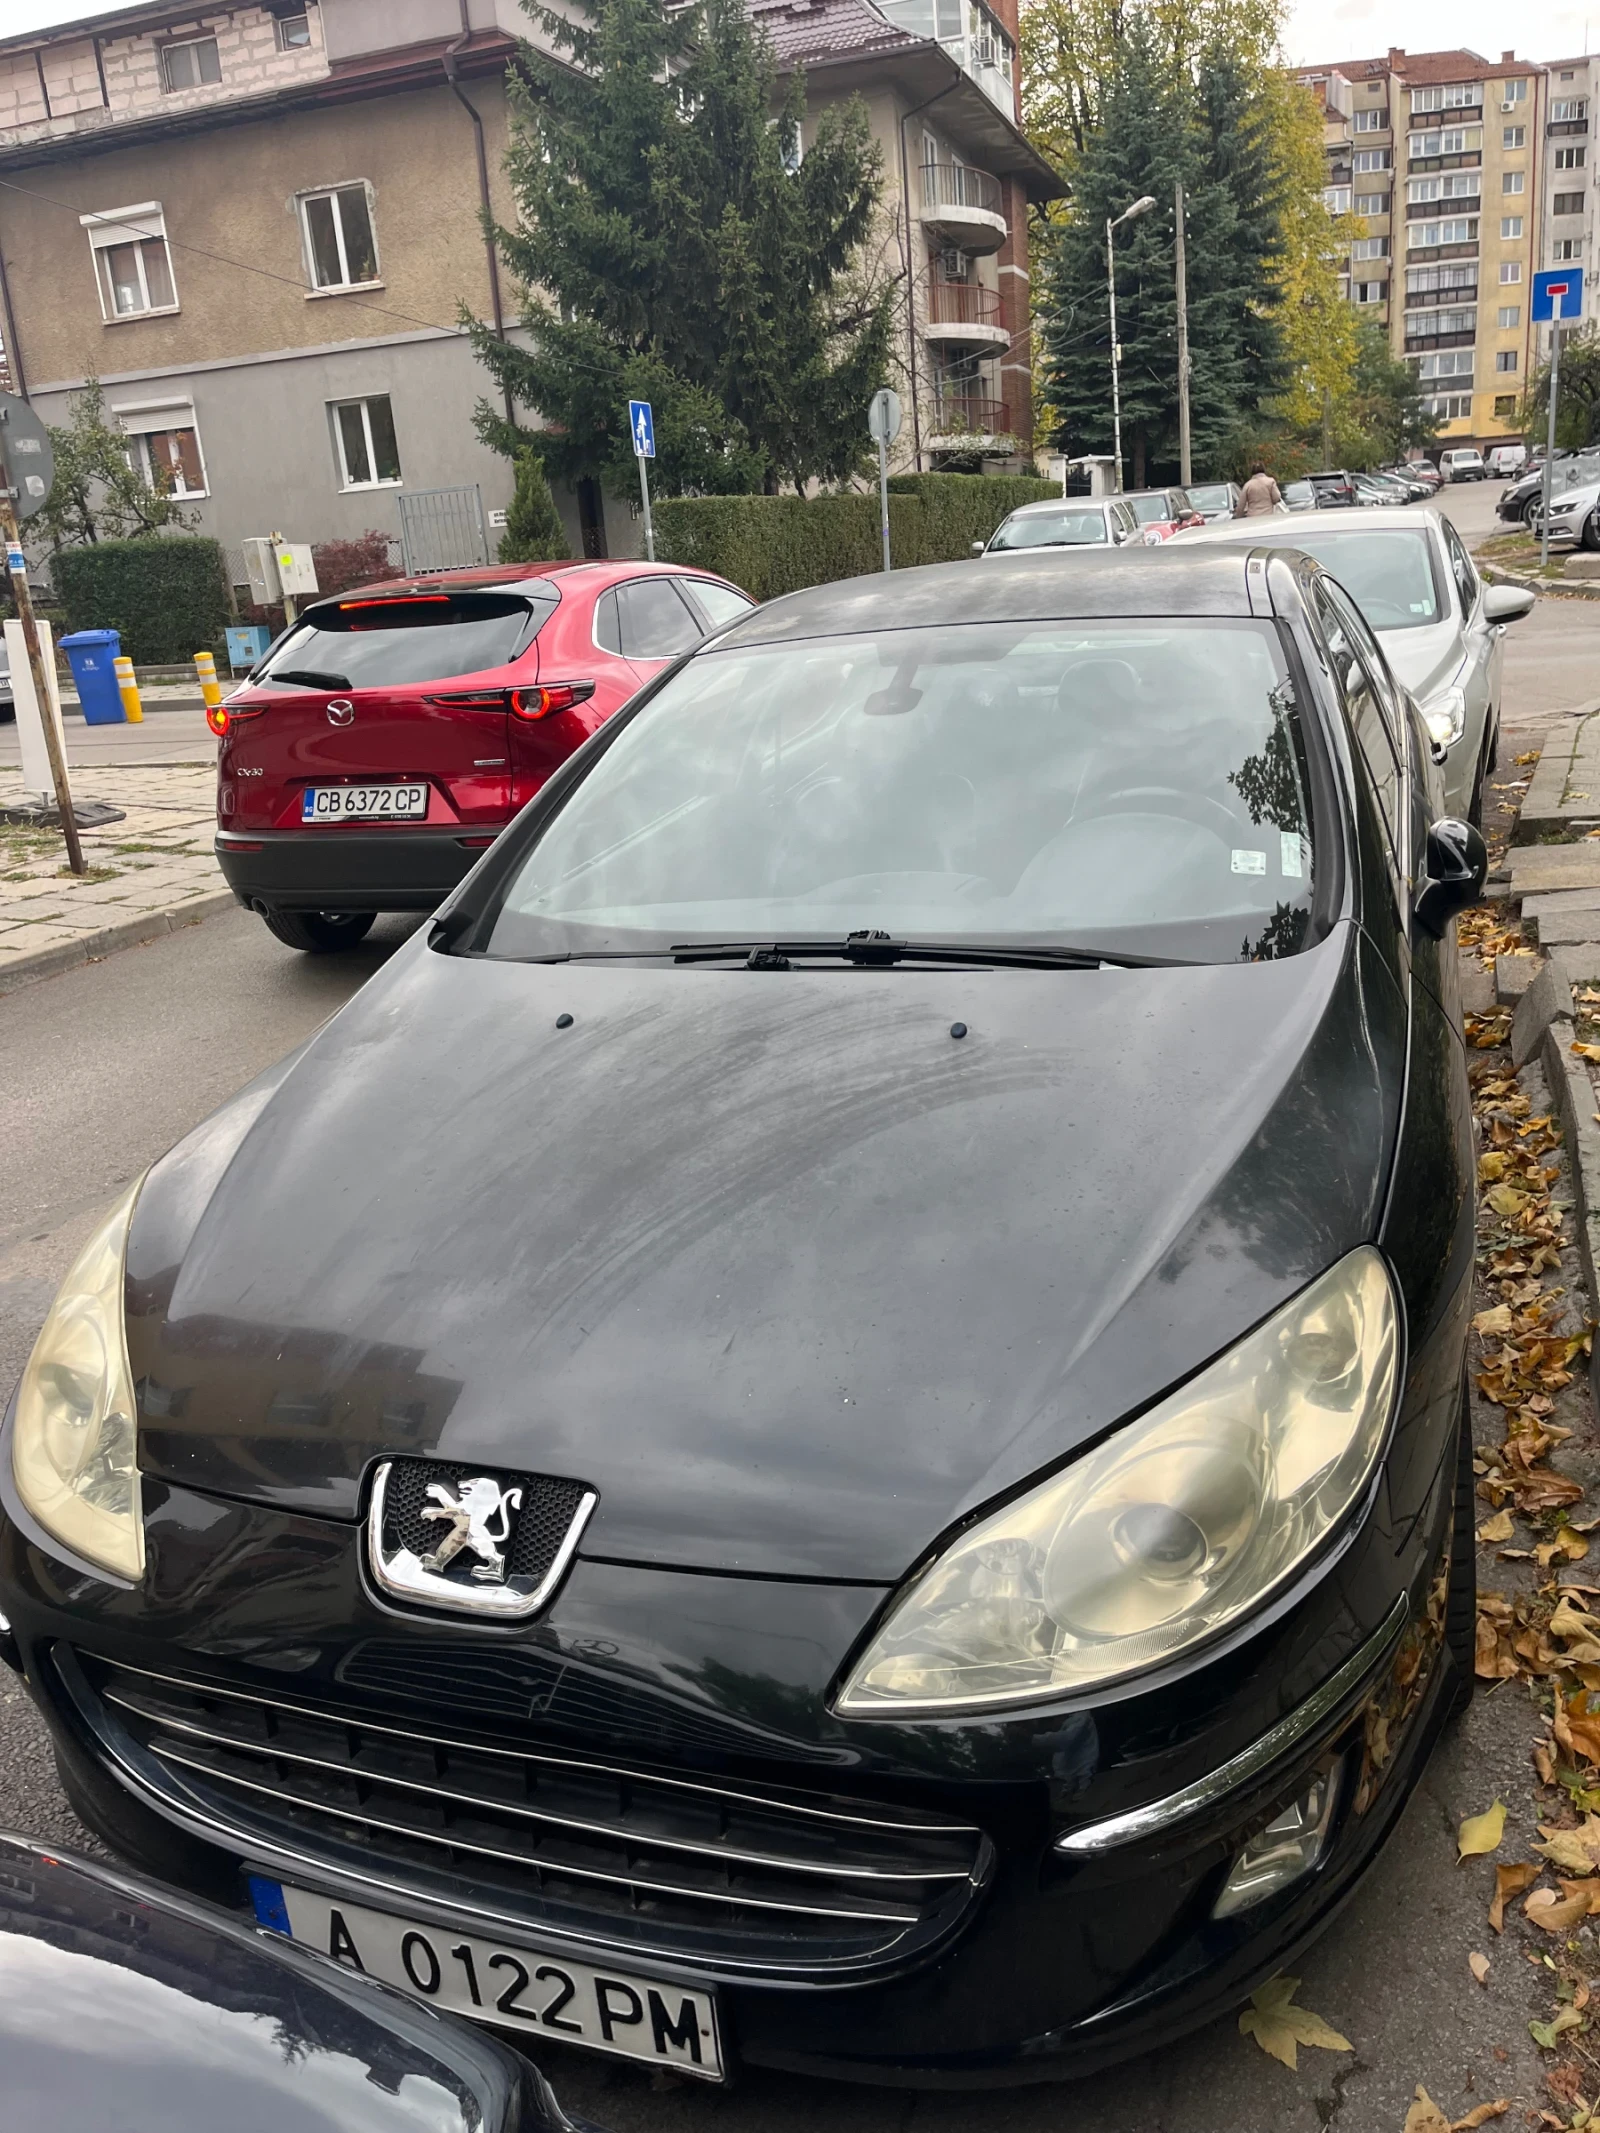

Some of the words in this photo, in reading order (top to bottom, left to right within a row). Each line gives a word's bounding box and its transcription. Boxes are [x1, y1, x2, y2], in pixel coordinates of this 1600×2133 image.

[237, 768, 263, 776] CX-30
[317, 791, 340, 812] CB
[345, 790, 391, 811] 6372
[396, 789, 421, 811] CP
[329, 1908, 366, 1972] A
[400, 1930, 583, 2035] 0122
[593, 1976, 704, 2065] PM
